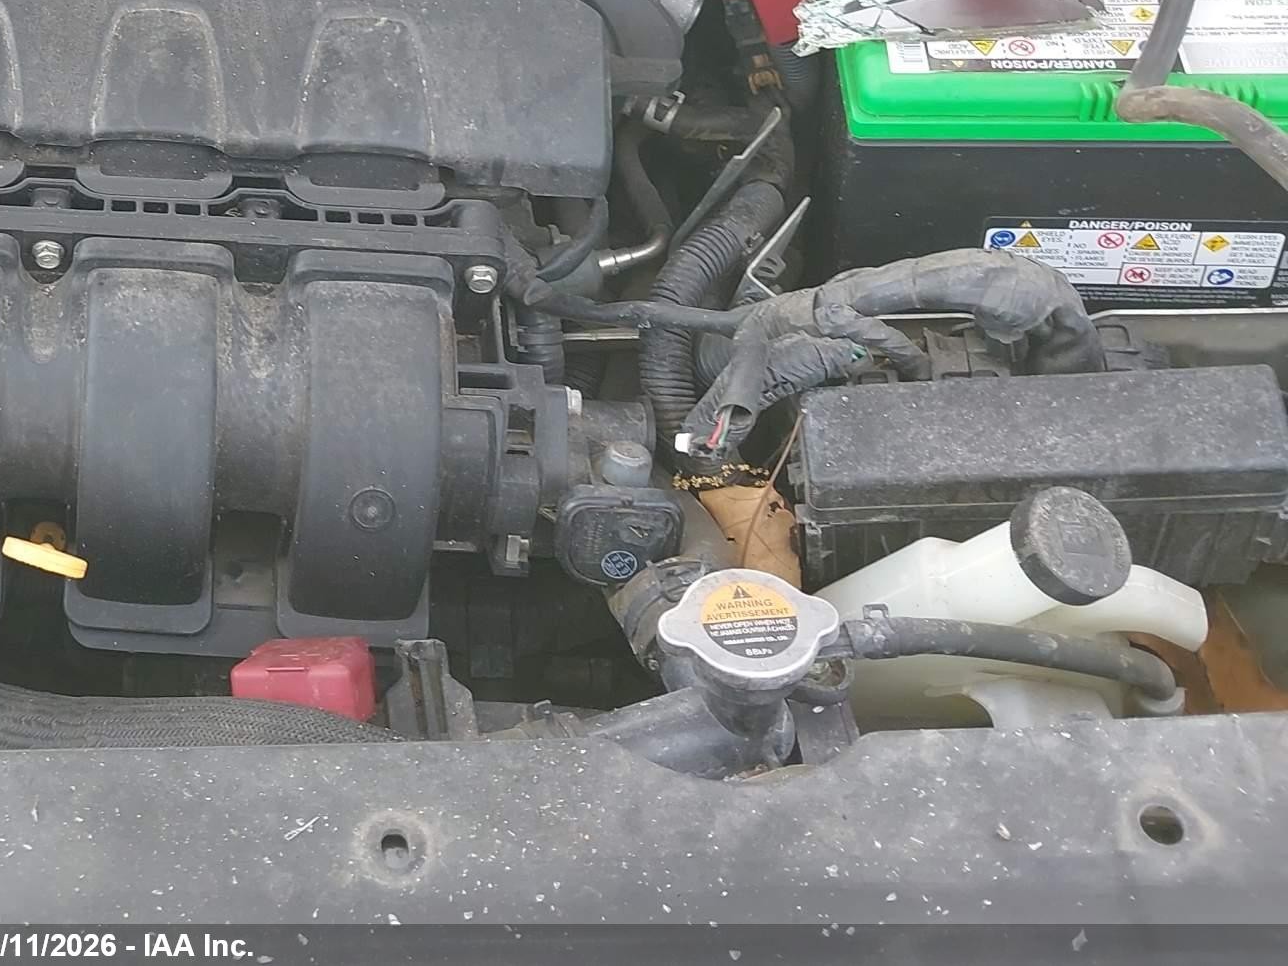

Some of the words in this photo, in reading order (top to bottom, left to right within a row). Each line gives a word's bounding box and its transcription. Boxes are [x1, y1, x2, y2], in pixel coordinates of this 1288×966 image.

[990, 59, 1117, 70] DANGER/POISON
[1069, 220, 1193, 231] DANGER/POISON
[715, 598, 773, 611] WARNING
[706, 607, 789, 622] AVERTISSEMENT
[733, 620, 753, 628] OPEN
